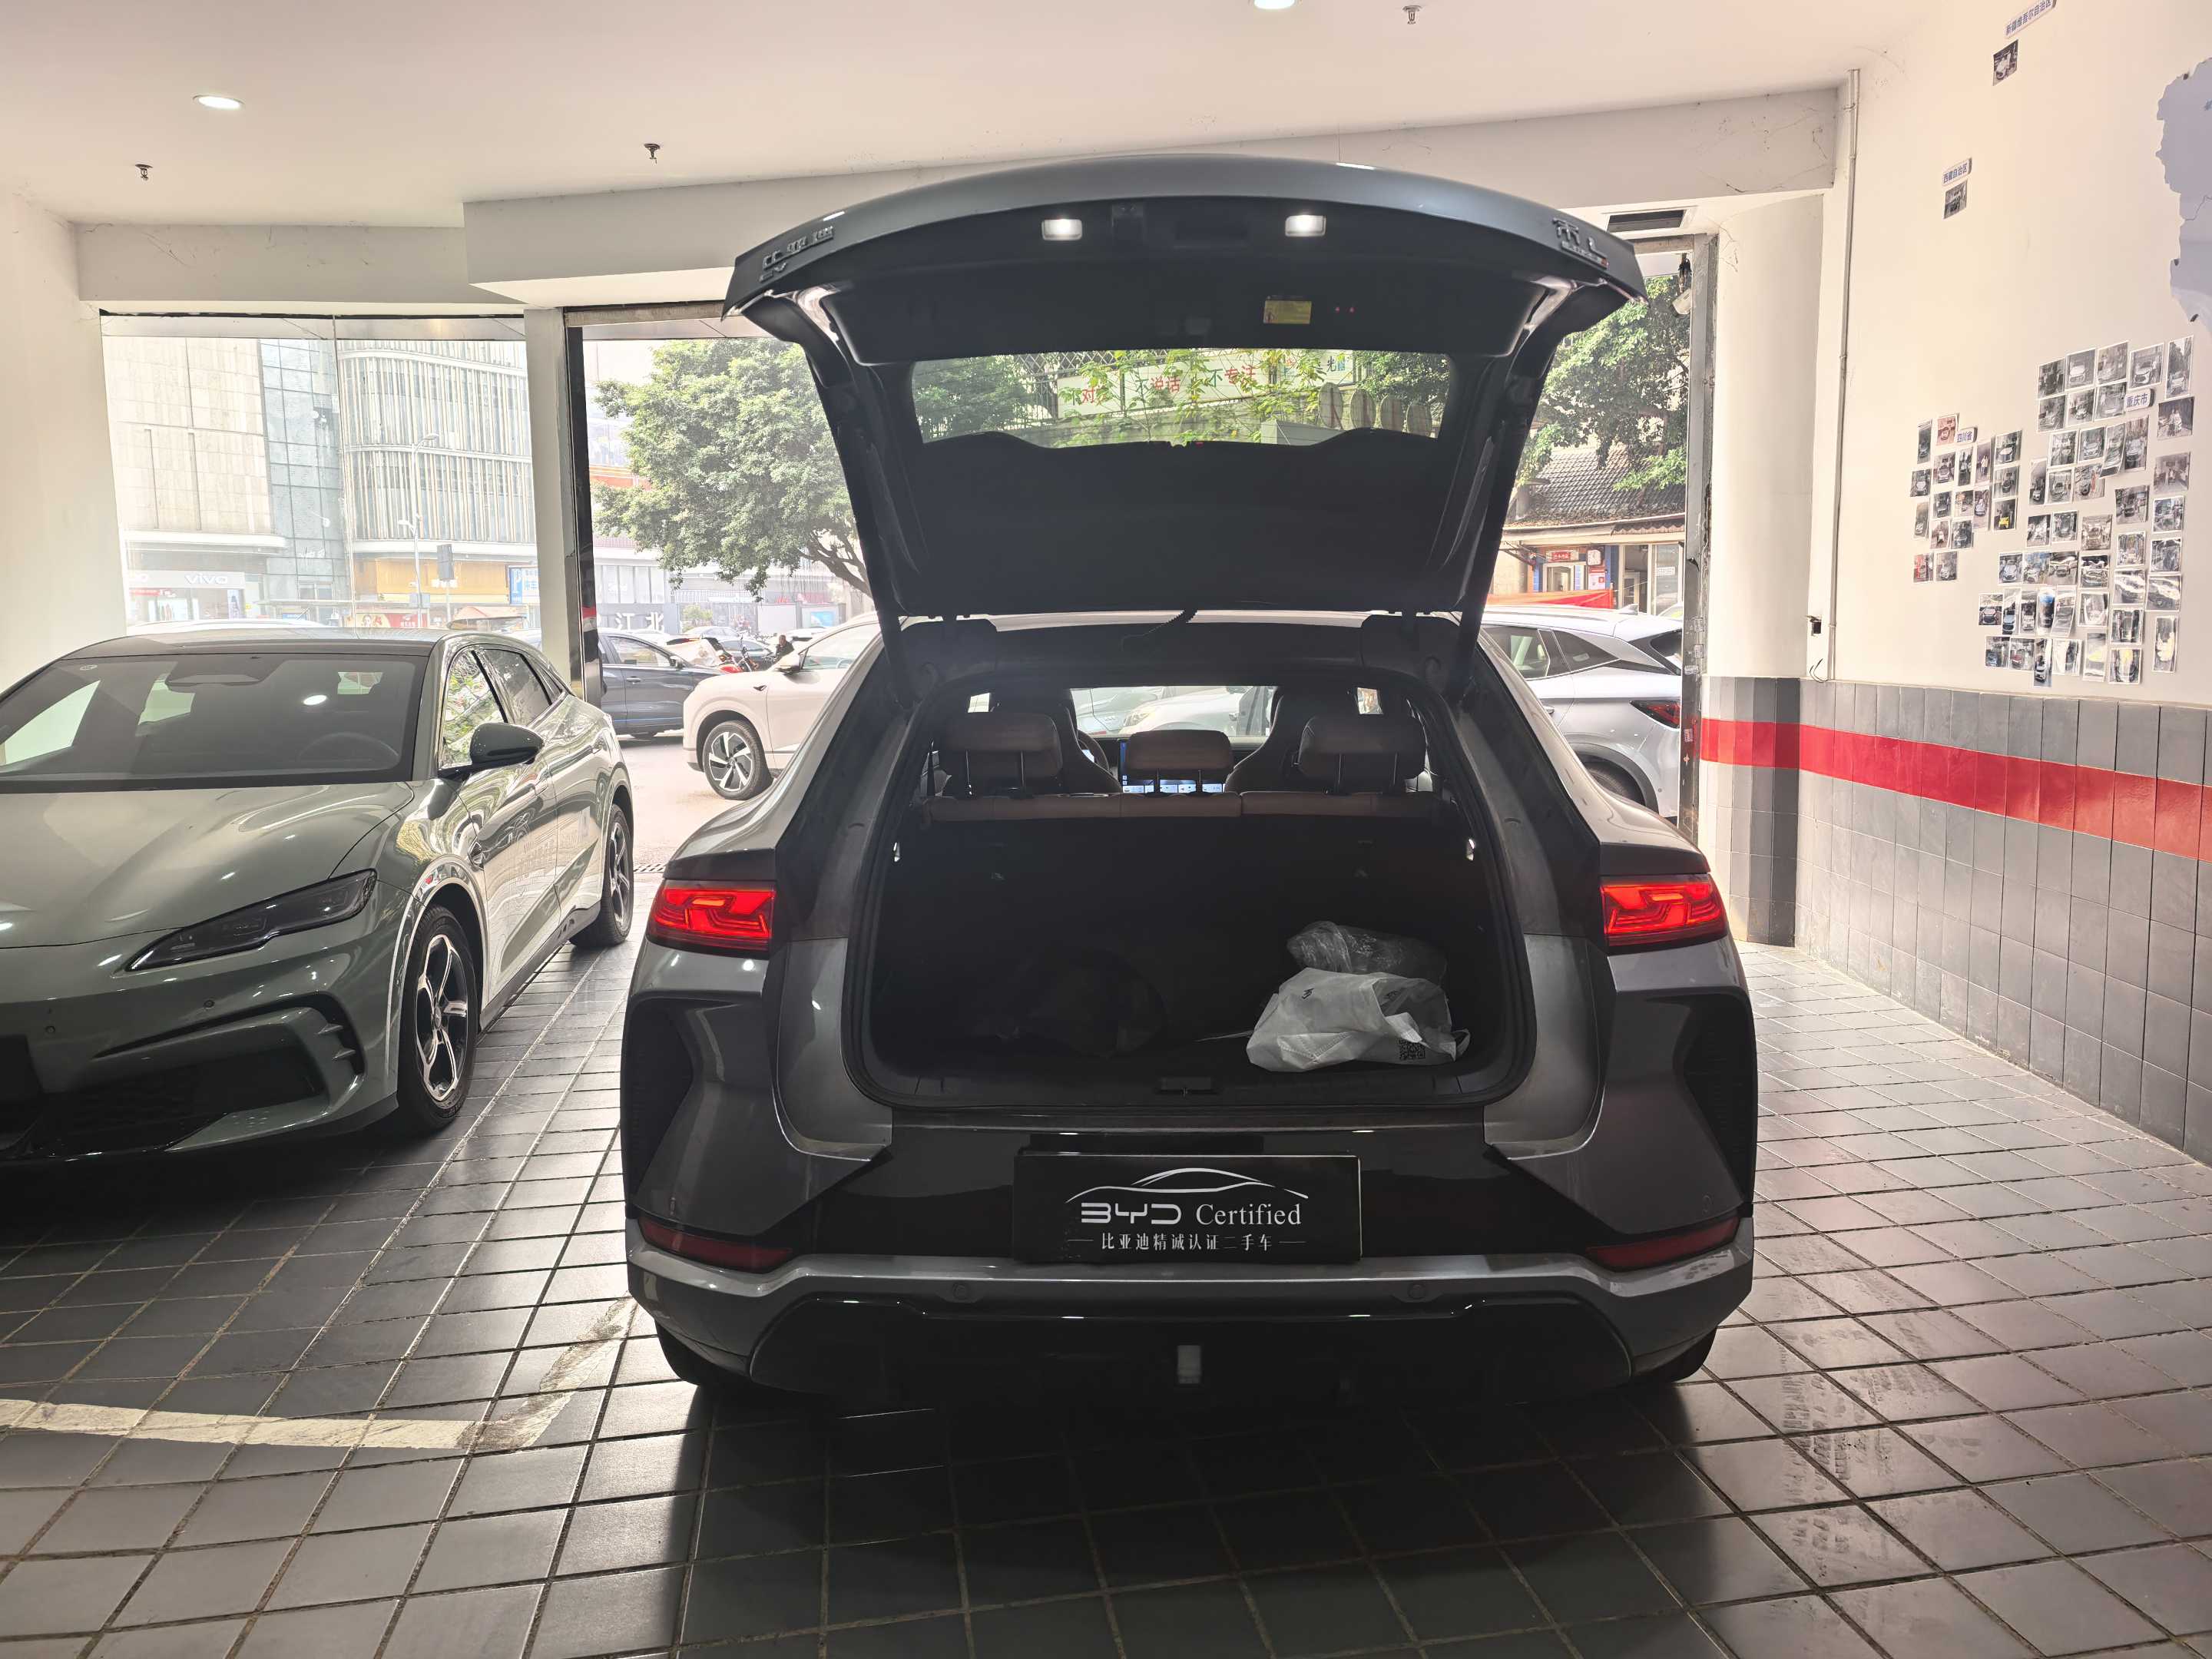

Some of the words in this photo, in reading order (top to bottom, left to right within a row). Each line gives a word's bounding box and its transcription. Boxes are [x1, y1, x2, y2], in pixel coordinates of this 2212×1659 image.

[2127, 392, 2148, 407] 重庆市
[1957, 431, 1972, 442] 四川省
[184, 572, 228, 584] vivo
[1081, 1203, 1182, 1225] BYD
[1196, 1204, 1302, 1225] Certified
[1101, 1232, 1273, 1251] 比亚迪精诚认证二手车
